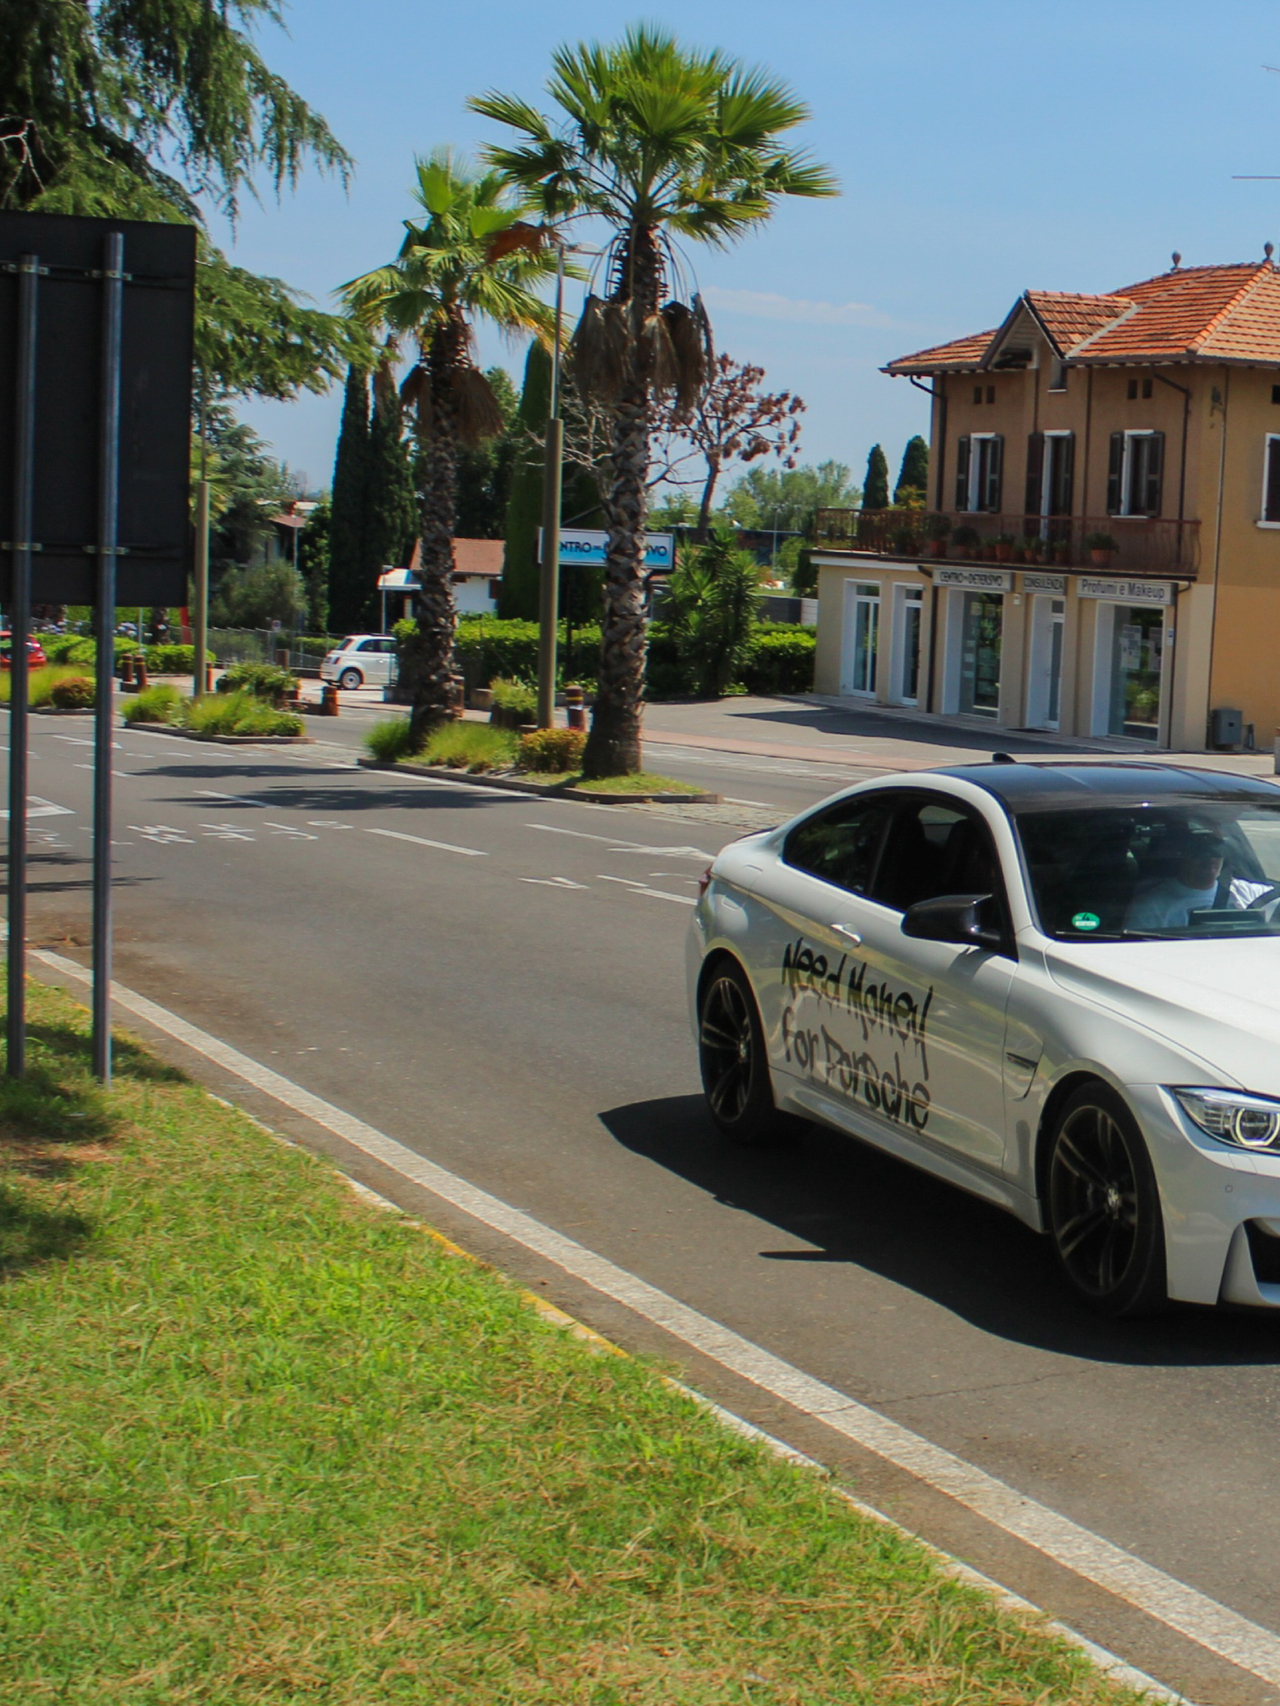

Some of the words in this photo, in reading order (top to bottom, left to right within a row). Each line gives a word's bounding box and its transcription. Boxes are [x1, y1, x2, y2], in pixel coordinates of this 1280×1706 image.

[560, 541, 592, 553] NTRO
[1024, 577, 1064, 590] CONSULENZA
[1081, 578, 1117, 595] Profumi
[1119, 585, 1126, 595] e
[1128, 582, 1165, 601] Makeup
[781, 937, 847, 1006] Need
[820, 1024, 931, 1132] Porsche
